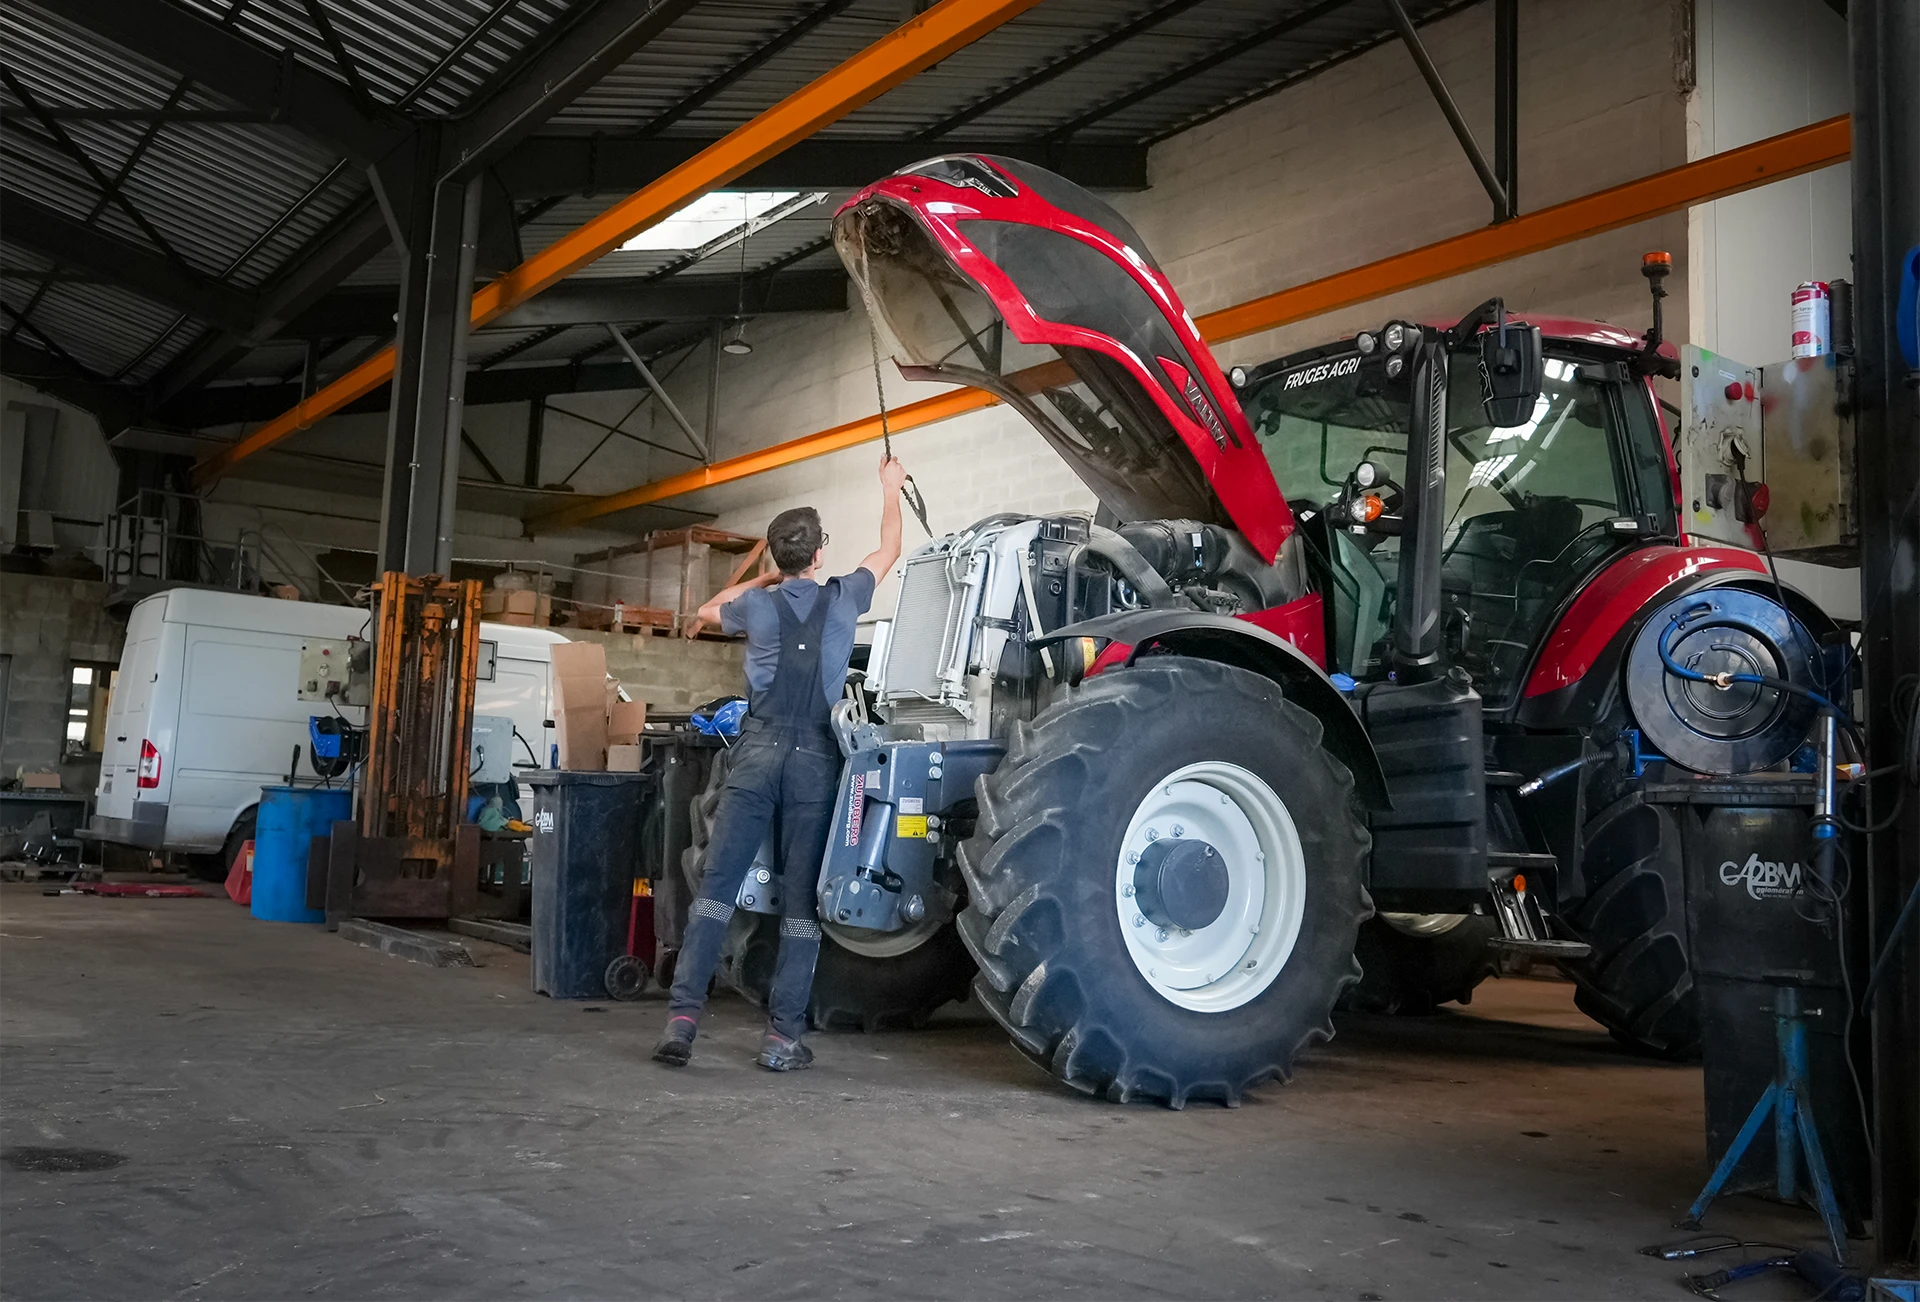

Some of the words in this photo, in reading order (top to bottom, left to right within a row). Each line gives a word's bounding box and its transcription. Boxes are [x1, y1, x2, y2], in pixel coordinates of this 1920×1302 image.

[1283, 363, 1331, 391] FRUGES
[1327, 356, 1362, 379] AGRI
[1184, 375, 1227, 454] VALTRA
[845, 774, 856, 847] www.zuidberg.com
[850, 774, 865, 847] ZUIDBERG
